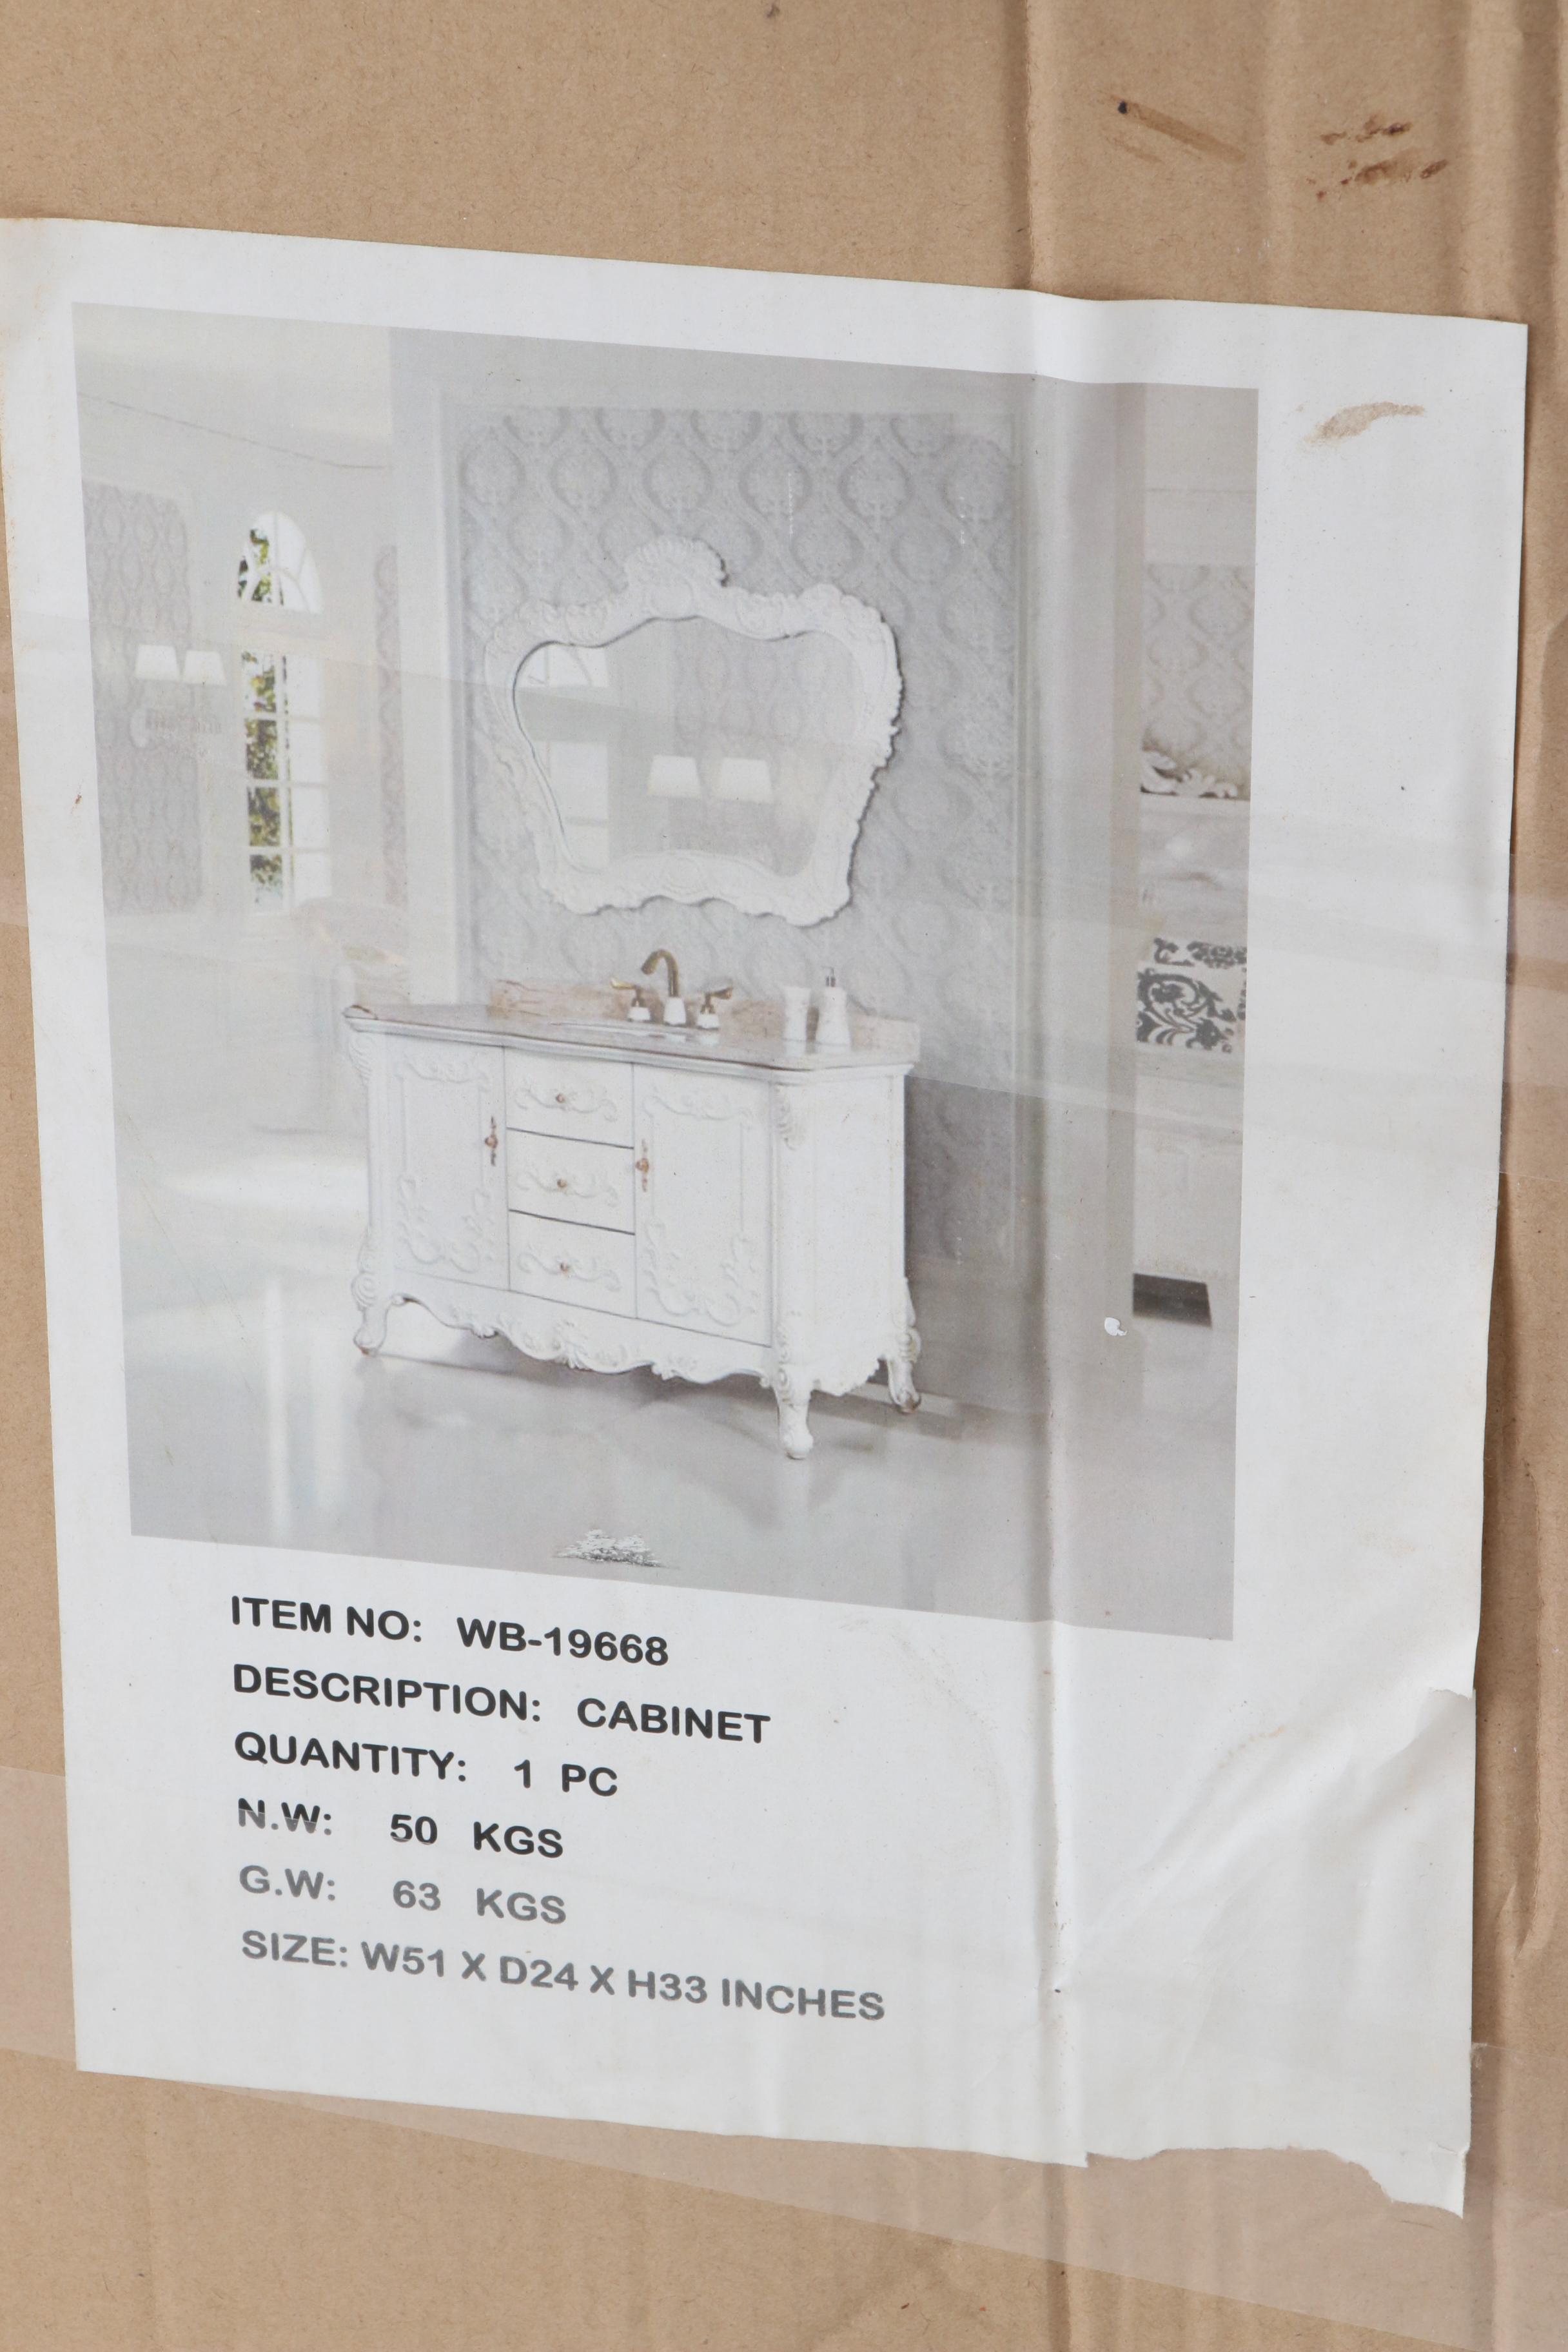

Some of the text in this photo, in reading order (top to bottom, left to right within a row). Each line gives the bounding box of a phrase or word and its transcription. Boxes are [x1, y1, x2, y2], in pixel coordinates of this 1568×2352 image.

[231, 1595, 669, 1667] ITEM NO: WB-19668
[233, 1663, 771, 1744] DESCRIPTION: CABINET
[234, 1731, 618, 1797] QUANTITY: 1 PC
[237, 1798, 564, 1859] N.W: 50 KGS
[239, 1865, 566, 1925] G.W: 63 KGS
[242, 1930, 885, 2021] SIZE: W51 X D24 X H33 INCHES
